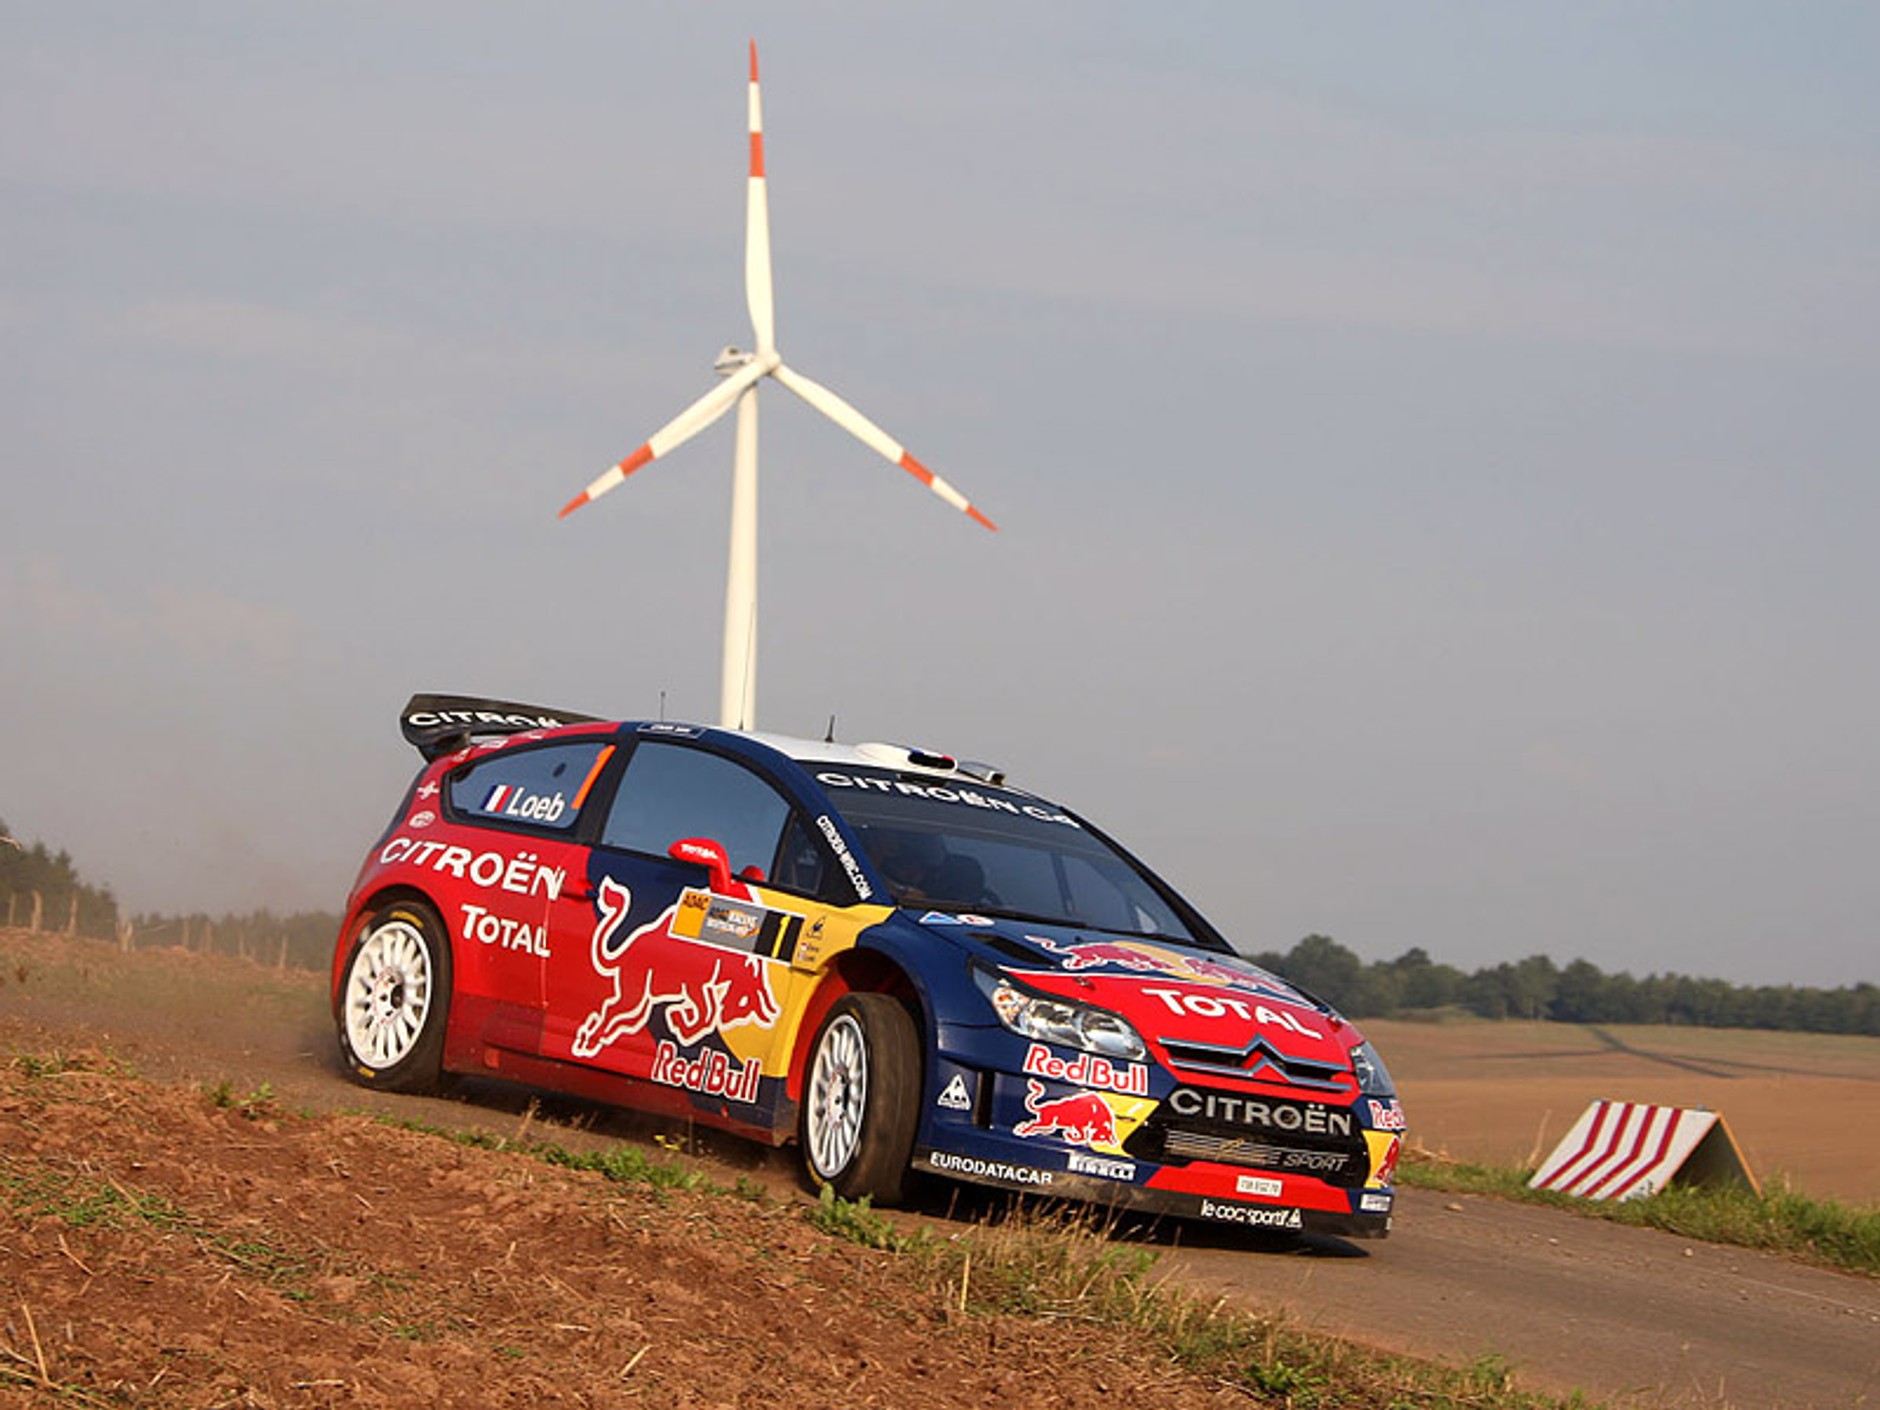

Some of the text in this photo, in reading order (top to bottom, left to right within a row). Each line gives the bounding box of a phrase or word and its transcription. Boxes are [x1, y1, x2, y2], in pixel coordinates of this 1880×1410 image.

[505, 786, 566, 822] Loeb
[380, 837, 566, 901] CITROËN
[460, 903, 551, 957] TOTAL
[770, 914, 792, 959] 1
[1140, 987, 1324, 1040] TOTAL
[651, 1039, 762, 1104] Red Bull
[1022, 1042, 1149, 1096] Red Bull
[1168, 1087, 1351, 1136] CITROËN
[929, 1151, 1053, 1185] EURODATACAR
[1282, 1152, 1350, 1172] SPORT
